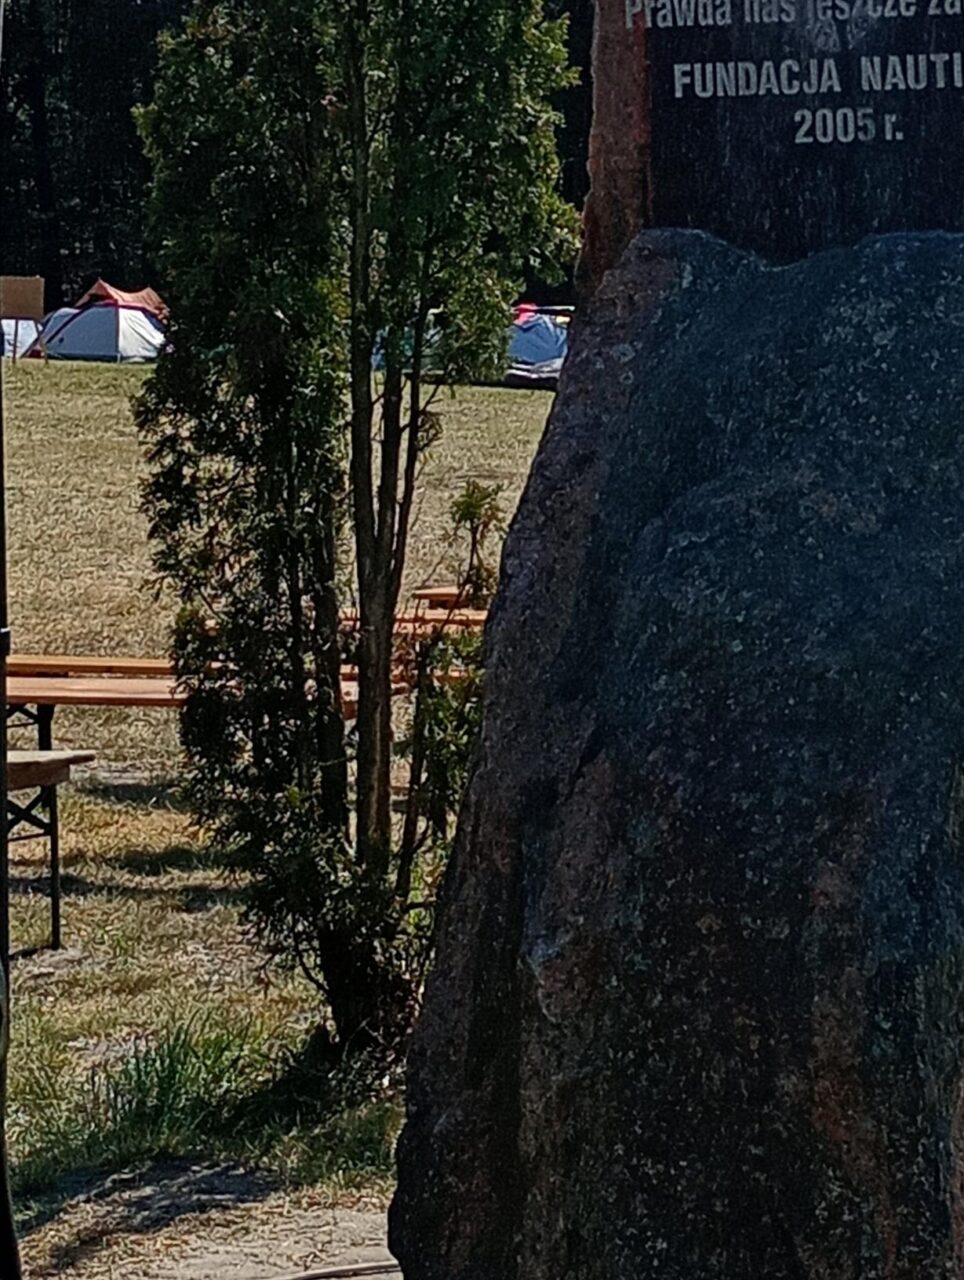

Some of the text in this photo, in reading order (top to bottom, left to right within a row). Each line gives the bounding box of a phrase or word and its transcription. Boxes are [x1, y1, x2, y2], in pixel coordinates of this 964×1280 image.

[673, 58, 842, 99] FUNDACJA
[794, 107, 904, 144] 2005 r.
